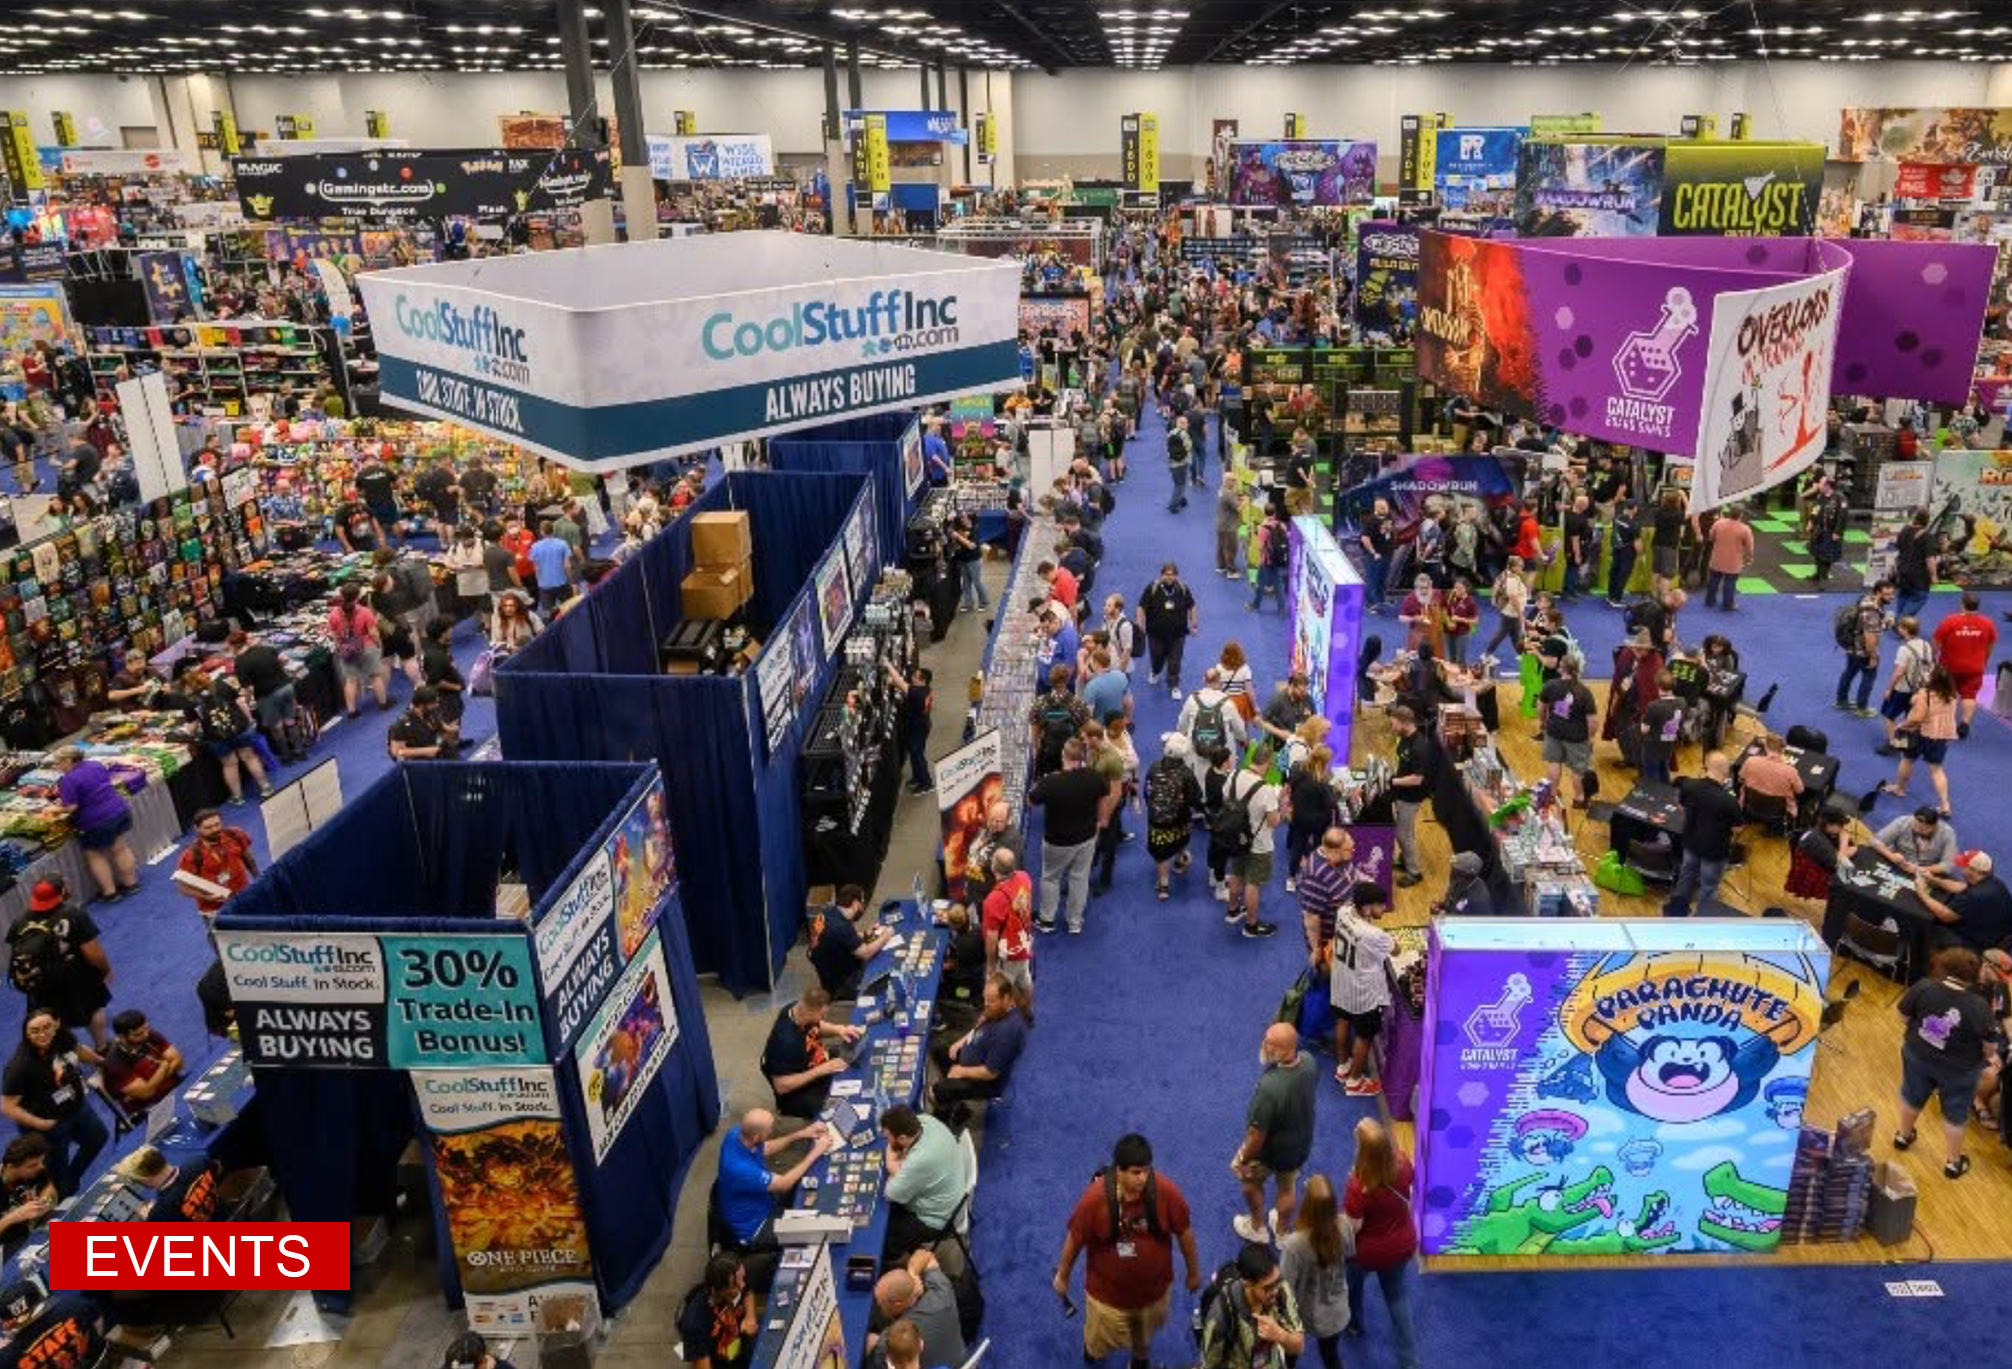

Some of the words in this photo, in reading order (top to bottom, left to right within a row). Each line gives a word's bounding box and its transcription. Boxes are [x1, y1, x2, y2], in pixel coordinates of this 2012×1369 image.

[342, 207, 363, 215] True
[1673, 182, 1805, 231] CATALYST
[395, 293, 528, 363] CoolStuffInc
[702, 288, 957, 361] CoolStuffInc
[766, 378, 845, 423] ALWAYS
[849, 364, 916, 405] BUYING
[1607, 396, 1676, 425] CATALYST
[1389, 480, 1478, 492] SHADOWRUN
[227, 943, 373, 965] CoolStuffInc
[401, 949, 519, 989] 30%
[557, 927, 610, 1017] ALWAYS
[233, 975, 267, 988] Cool
[314, 978, 329, 990] In
[333, 977, 380, 991] Stock.
[396, 998, 535, 1024] Trade-In
[559, 954, 615, 1044] BUYING
[1595, 976, 1790, 1021] PARACHUTE
[256, 1009, 372, 1032] ALWAYS
[1637, 1001, 1742, 1031] PANDA
[260, 1034, 374, 1059] BUYING
[417, 1030, 527, 1054] Bonus!
[1461, 1049, 1518, 1062] CATALYST
[425, 1077, 547, 1094] CoolStuffInc
[430, 1103, 459, 1114] Cool
[499, 1101, 512, 1112] In
[467, 1250, 516, 1266] ONE
[521, 1248, 578, 1264] PIECE
